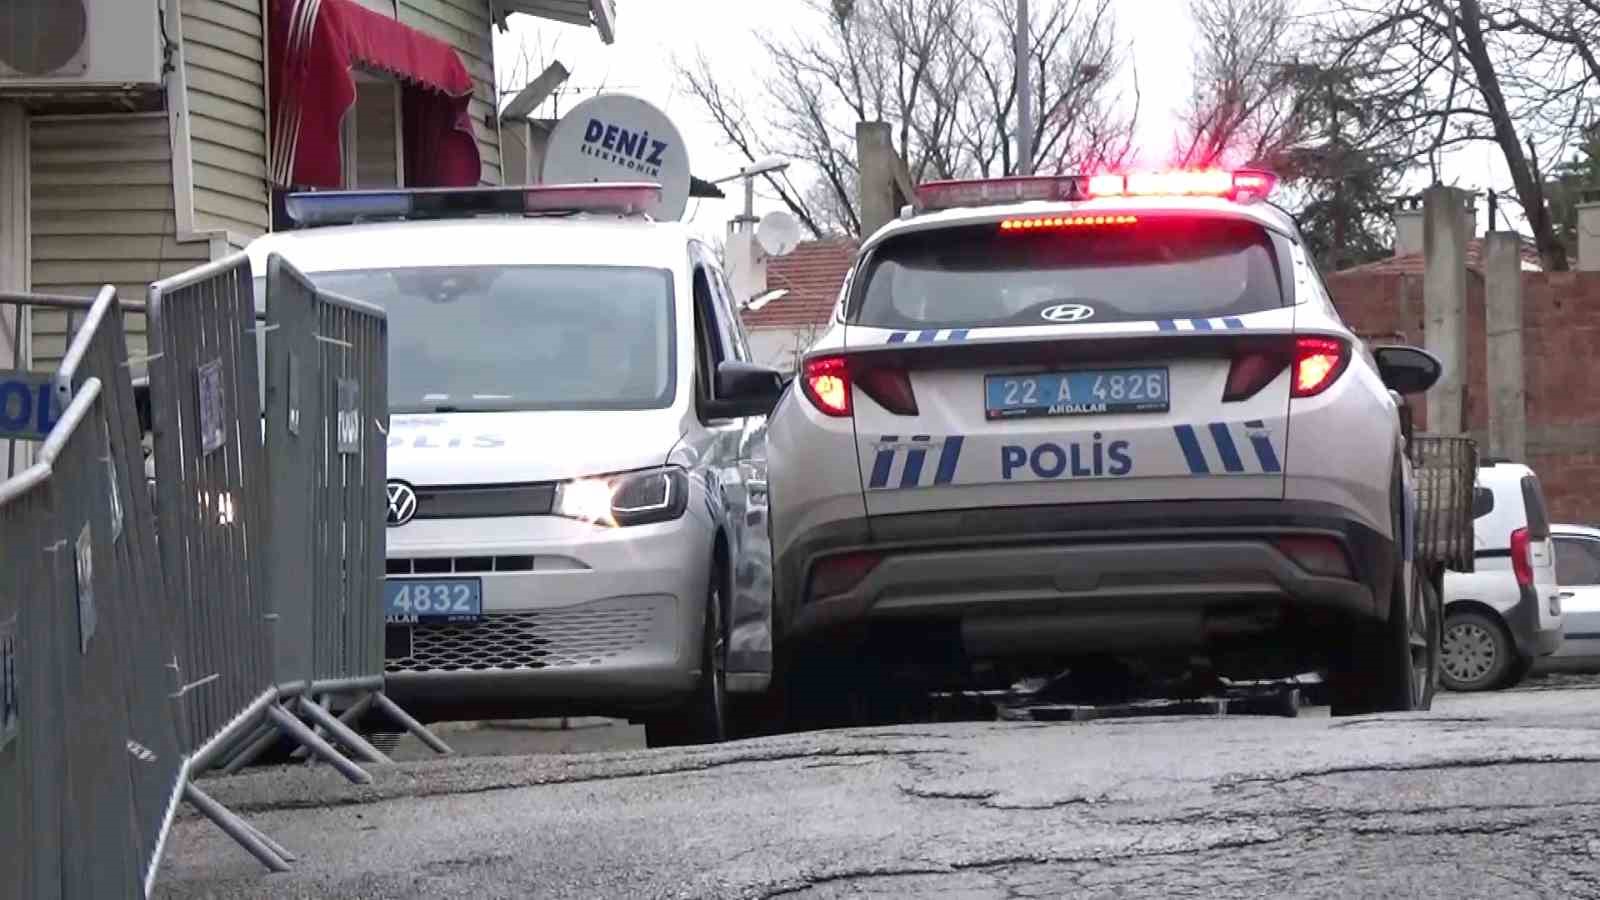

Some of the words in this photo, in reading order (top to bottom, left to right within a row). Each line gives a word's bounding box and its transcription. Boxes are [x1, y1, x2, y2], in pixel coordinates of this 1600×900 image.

[584, 118, 668, 167] DENİZ
[1004, 379, 1038, 405] 22
[1057, 376, 1072, 402] A
[1092, 374, 1162, 401] 4826
[1002, 431, 1133, 481] POLİS
[393, 584, 471, 612] 4832
